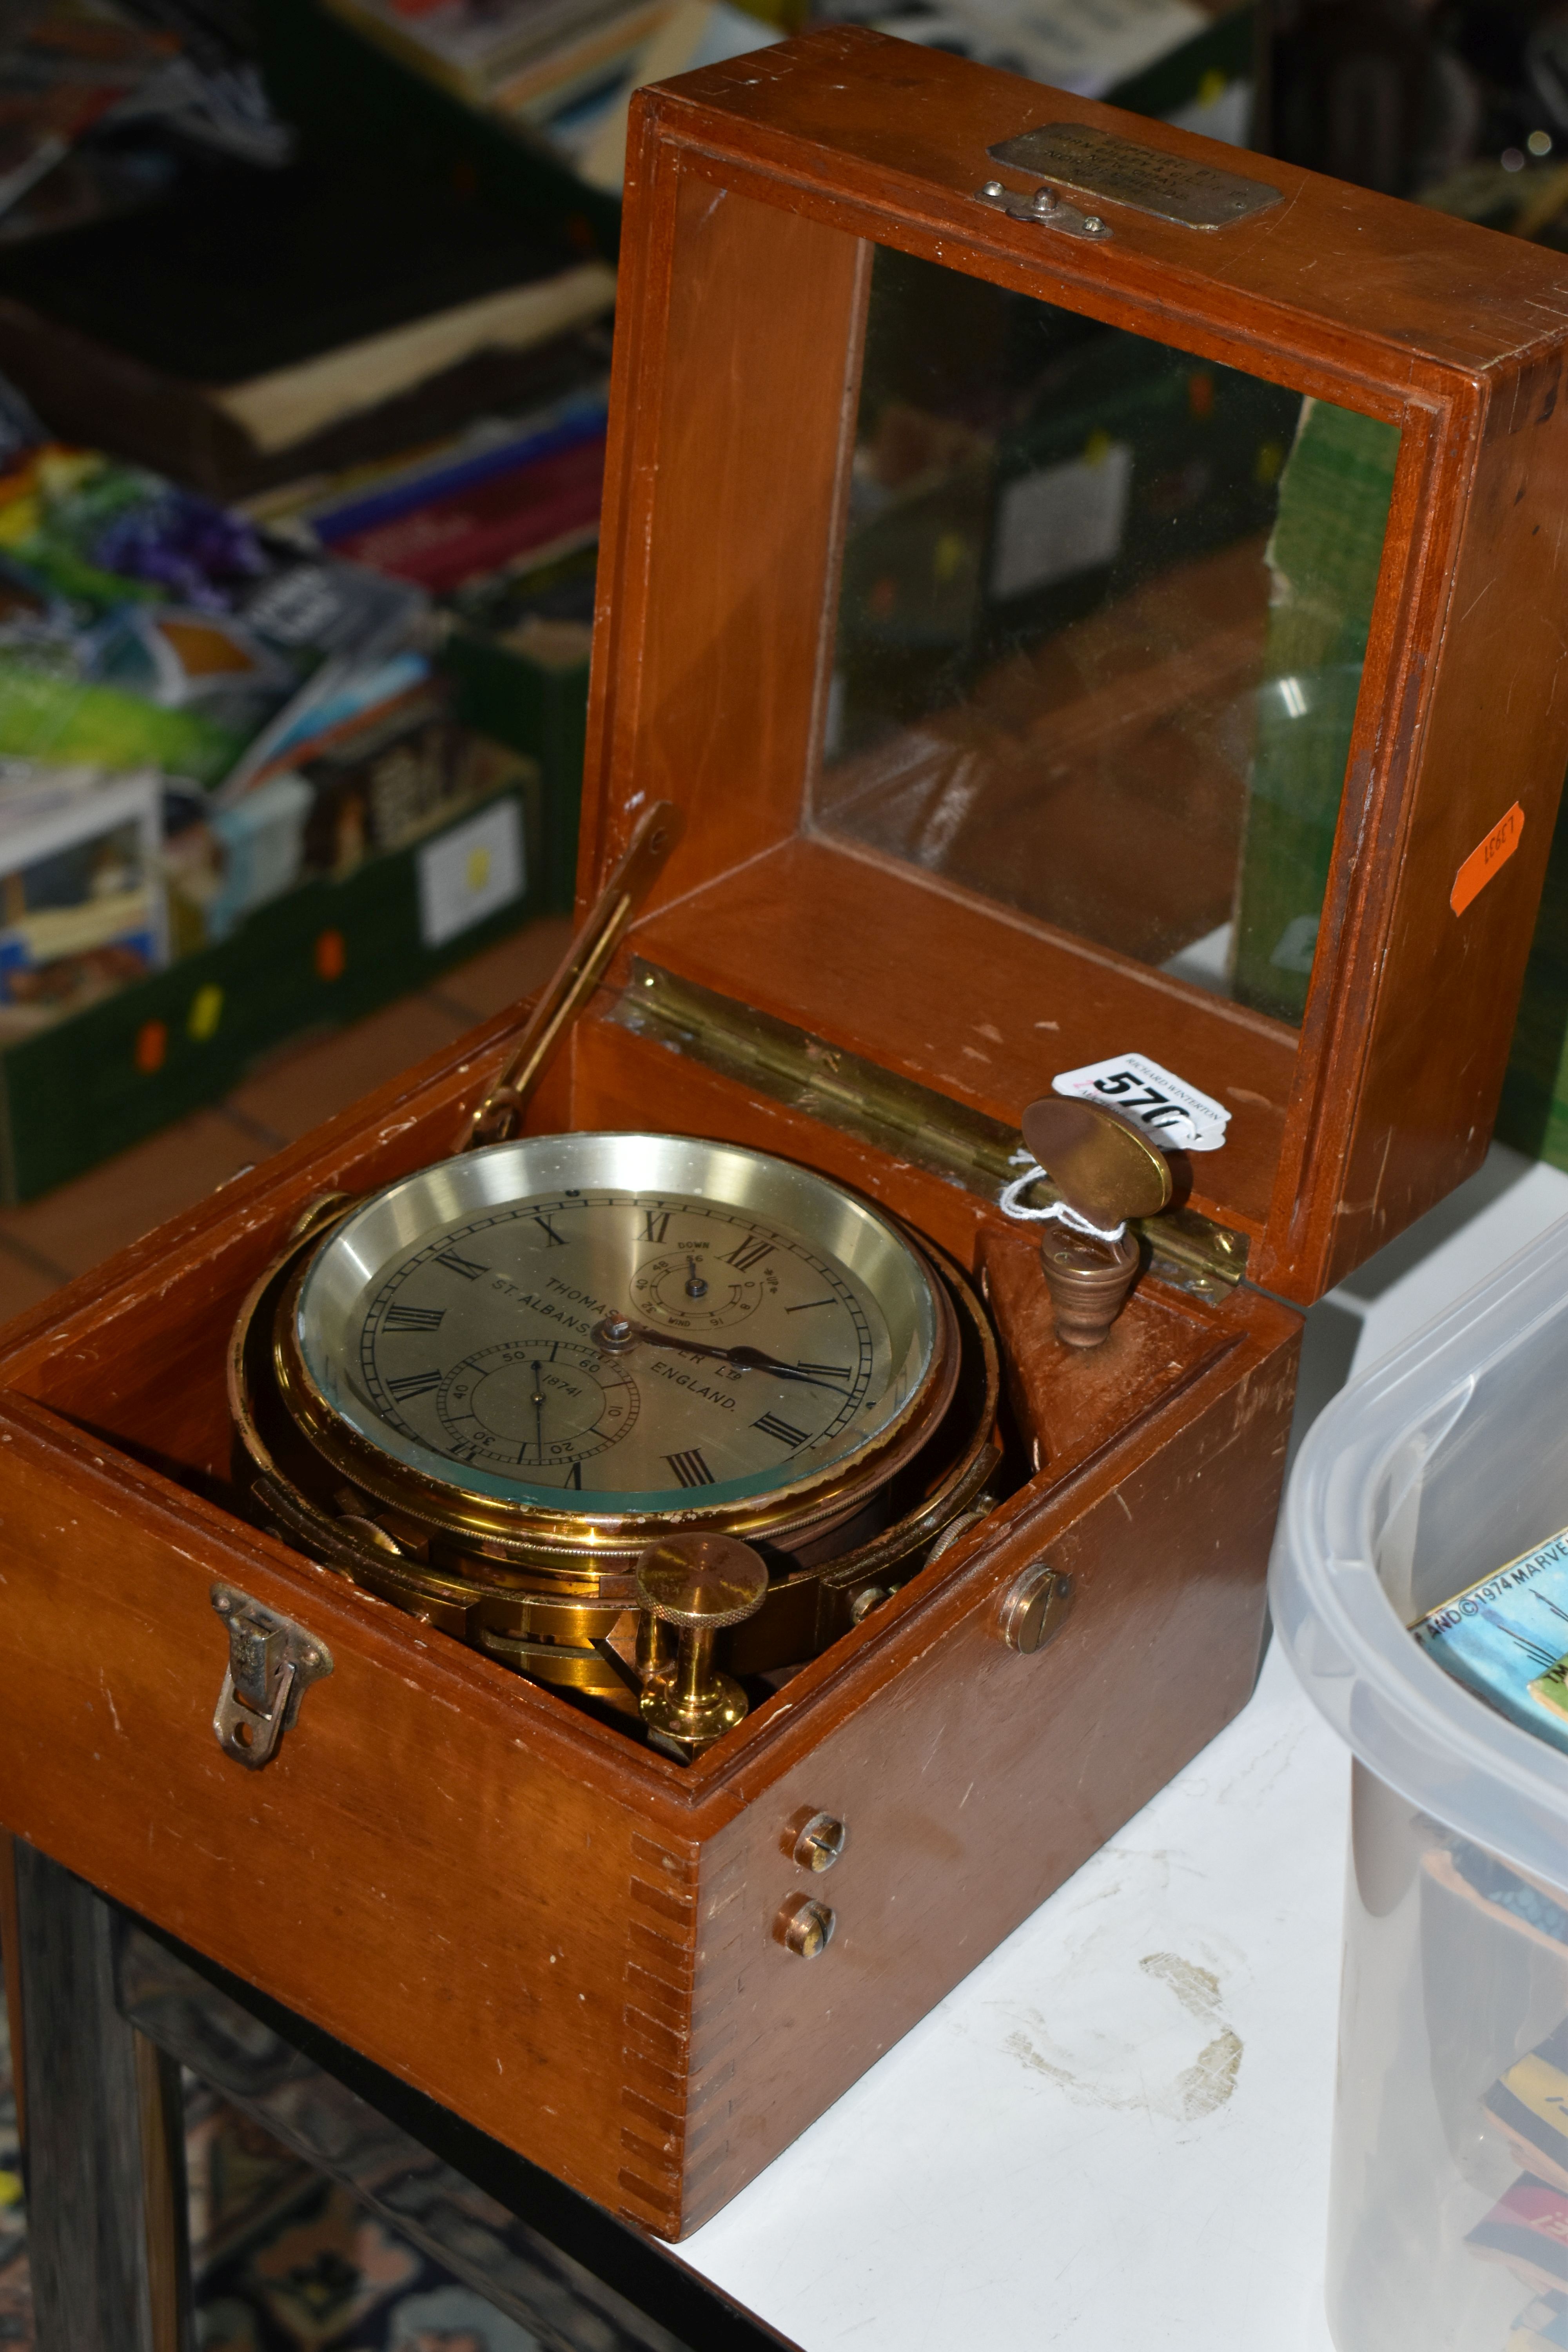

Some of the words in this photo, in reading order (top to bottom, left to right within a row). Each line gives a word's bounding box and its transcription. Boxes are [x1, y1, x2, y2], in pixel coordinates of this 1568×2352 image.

[1103, 139, 1188, 169] SUPPLIED
[1196, 170, 1221, 180] BY
[1110, 172, 1187, 200] SHIELDS
[1132, 169, 1177, 187] QUAY
[1484, 815, 1514, 865] L3931
[1093, 1071, 1191, 1128] 570
[1125, 1057, 1168, 1086] RICHARD
[1167, 1084, 1222, 1121] WINTERTON
[531, 1214, 570, 1248] X
[632, 1209, 677, 1244] XI
[678, 1241, 710, 1249] DOWN
[713, 1234, 780, 1273] XII
[432, 1248, 492, 1282] IX
[652, 1260, 669, 1271] 48
[545, 1277, 619, 1319] THOMAS
[635, 1278, 649, 1291] 40
[381, 1302, 447, 1333] VIII
[641, 1301, 658, 1314] 32
[668, 1317, 691, 1327] WIND
[709, 1318, 724, 1326] 16
[492, 1279, 519, 1296] ST.
[518, 1295, 591, 1337] ALBANS,
[650, 1361, 736, 1412] ENGLAND.
[503, 1351, 526, 1362] 50
[579, 1359, 601, 1373] 60
[385, 1369, 443, 1405] VII
[453, 1384, 468, 1400] 40
[542, 1374, 583, 1398] 18741
[608, 1405, 623, 1417] 10
[473, 1431, 496, 1446] 30
[748, 1411, 813, 1450] III
[550, 1442, 574, 1454] 20
[1426, 1609, 1462, 1640] AND
[1510, 1539, 1568, 1585] MARVE
